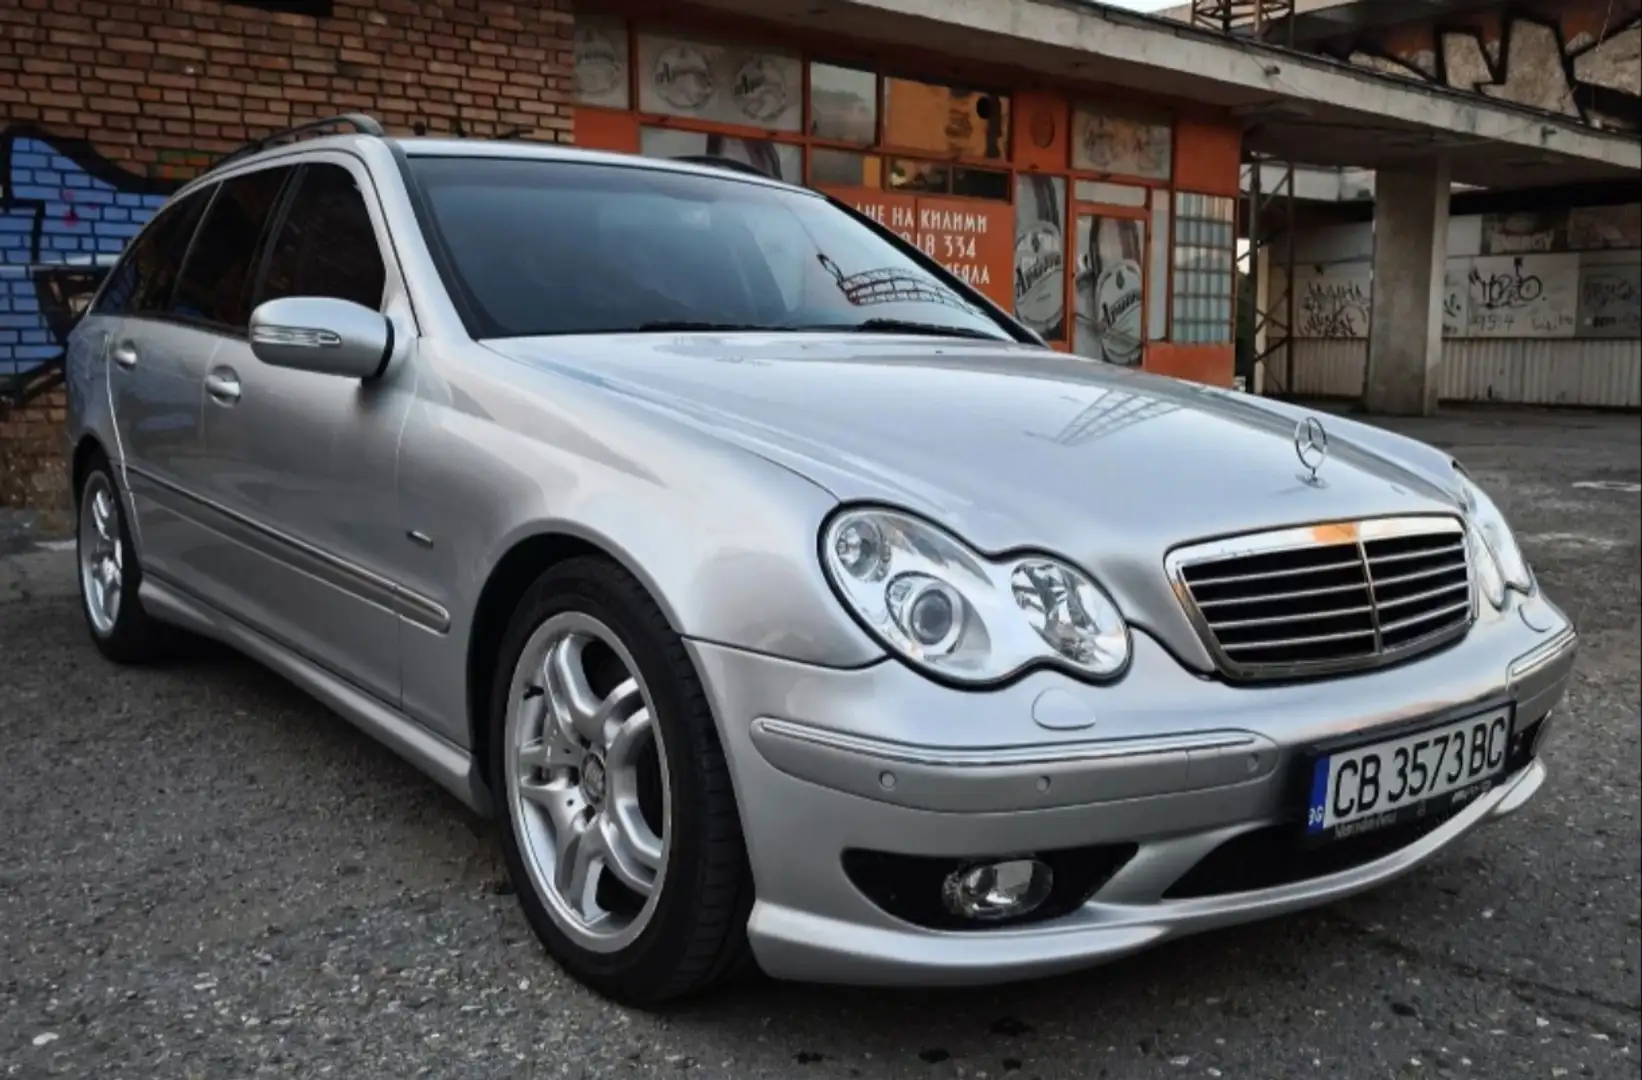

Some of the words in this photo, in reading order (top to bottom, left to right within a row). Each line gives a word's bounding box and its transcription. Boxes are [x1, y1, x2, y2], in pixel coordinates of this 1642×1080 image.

[892, 207, 914, 228] НА
[921, 208, 988, 233] КИЛИМИ
[943, 234, 976, 260] 334
[1388, 730, 1466, 803] 3573
